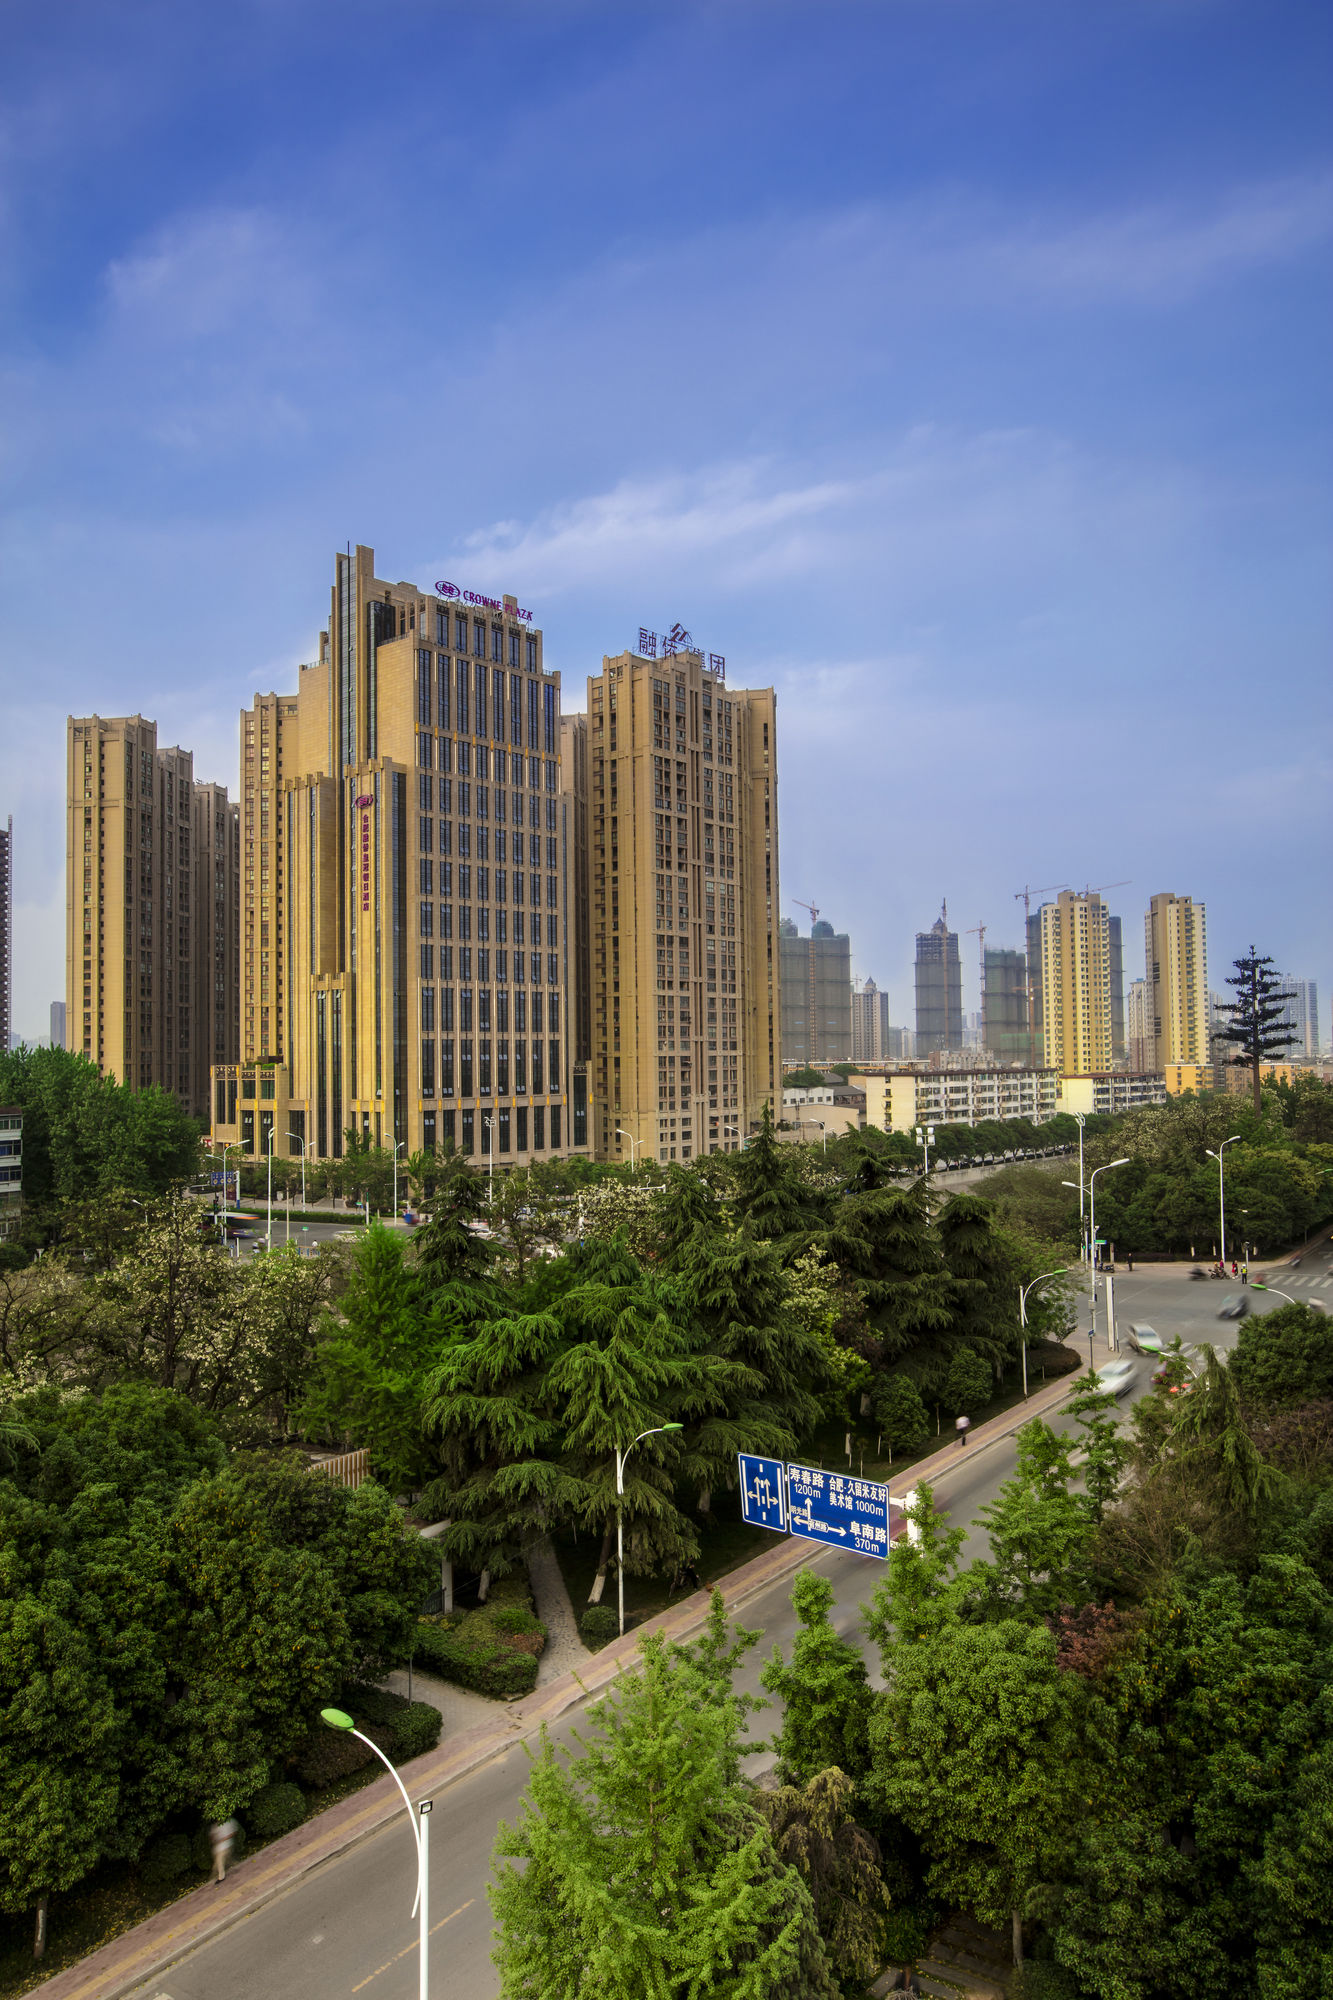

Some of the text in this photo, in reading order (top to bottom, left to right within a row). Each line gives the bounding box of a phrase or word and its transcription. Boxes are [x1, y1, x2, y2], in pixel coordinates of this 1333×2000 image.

[463, 590, 532, 621] CROWNE PLAZA
[789, 1467, 824, 1488] 寿春路
[794, 1483, 821, 1499] 1200m
[829, 1491, 884, 1517] 美术馆 1000m
[850, 1520, 887, 1544] 阜南路
[854, 1537, 880, 1553] 370m
